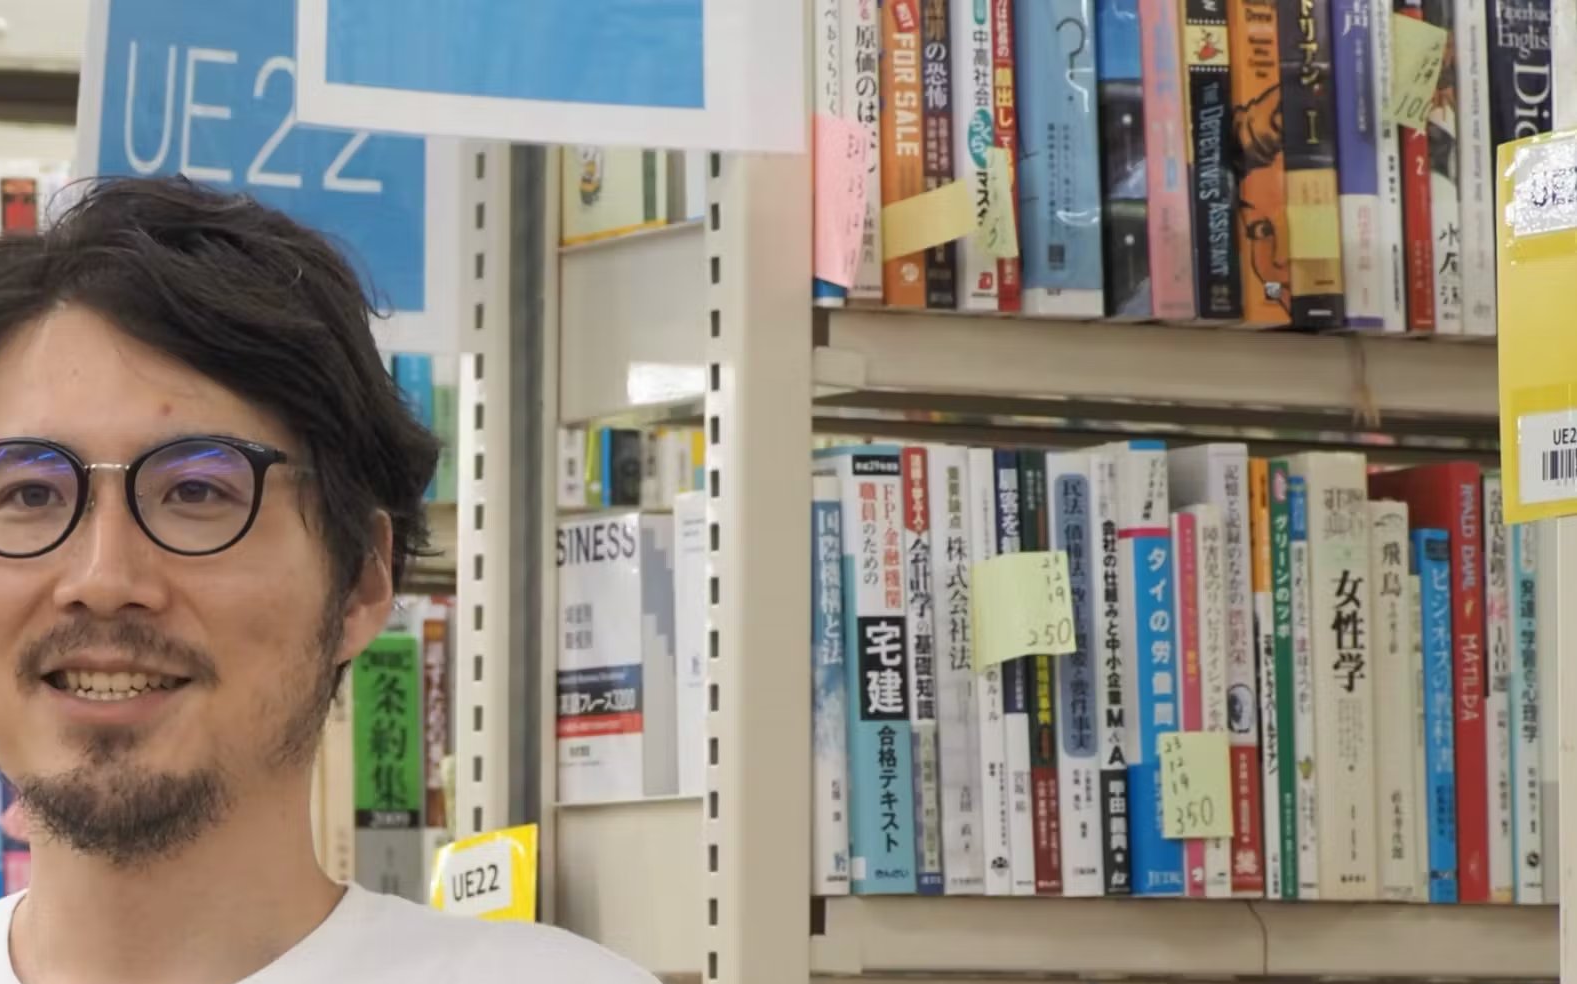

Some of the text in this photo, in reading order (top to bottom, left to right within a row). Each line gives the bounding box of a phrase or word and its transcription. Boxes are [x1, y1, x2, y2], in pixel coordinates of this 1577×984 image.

[893, 33, 916, 83] FOR
[894, 91, 919, 156] SALE
[1552, 427, 1577, 446] UE2
[556, 522, 636, 568] SINESS
[859, 483, 879, 585] 職員のための
[1381, 542, 1401, 597] 飛鳥
[946, 537, 972, 672] 株式会社法
[1146, 547, 1175, 728] タイの労働問
[1331, 569, 1367, 693] 女性学
[864, 622, 905, 714] 宅建
[1461, 634, 1479, 721] MATILDA
[369, 671, 409, 808] 条約集
[877, 725, 900, 852] 合格テキスト
[452, 863, 500, 901] UE22
